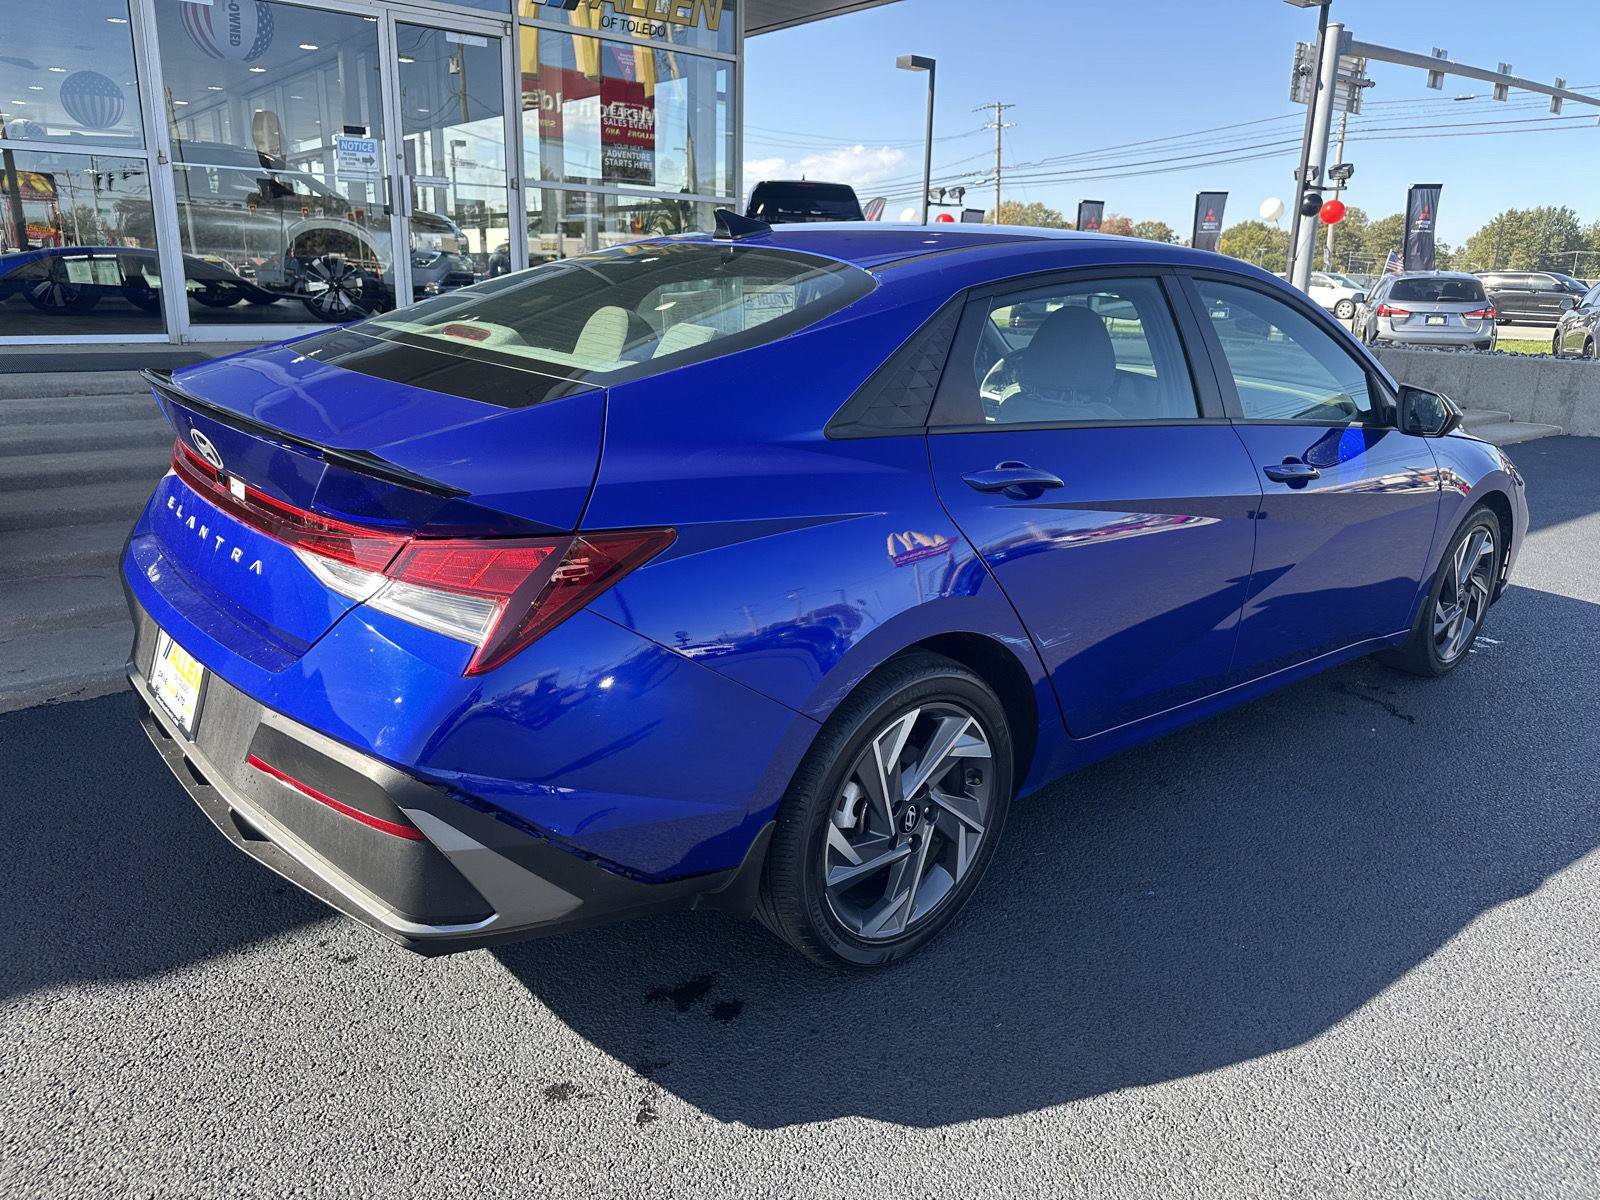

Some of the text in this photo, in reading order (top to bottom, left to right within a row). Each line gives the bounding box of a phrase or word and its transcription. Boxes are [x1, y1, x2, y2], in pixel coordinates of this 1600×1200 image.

[601, 15, 666, 37] OF TOLEDO
[603, 117, 653, 131] SALES EVENT
[341, 140, 374, 152] NOTICE
[606, 149, 651, 161] ADVENTURE
[604, 157, 653, 170] STARTS HERE
[167, 495, 263, 576] ELANTRA
